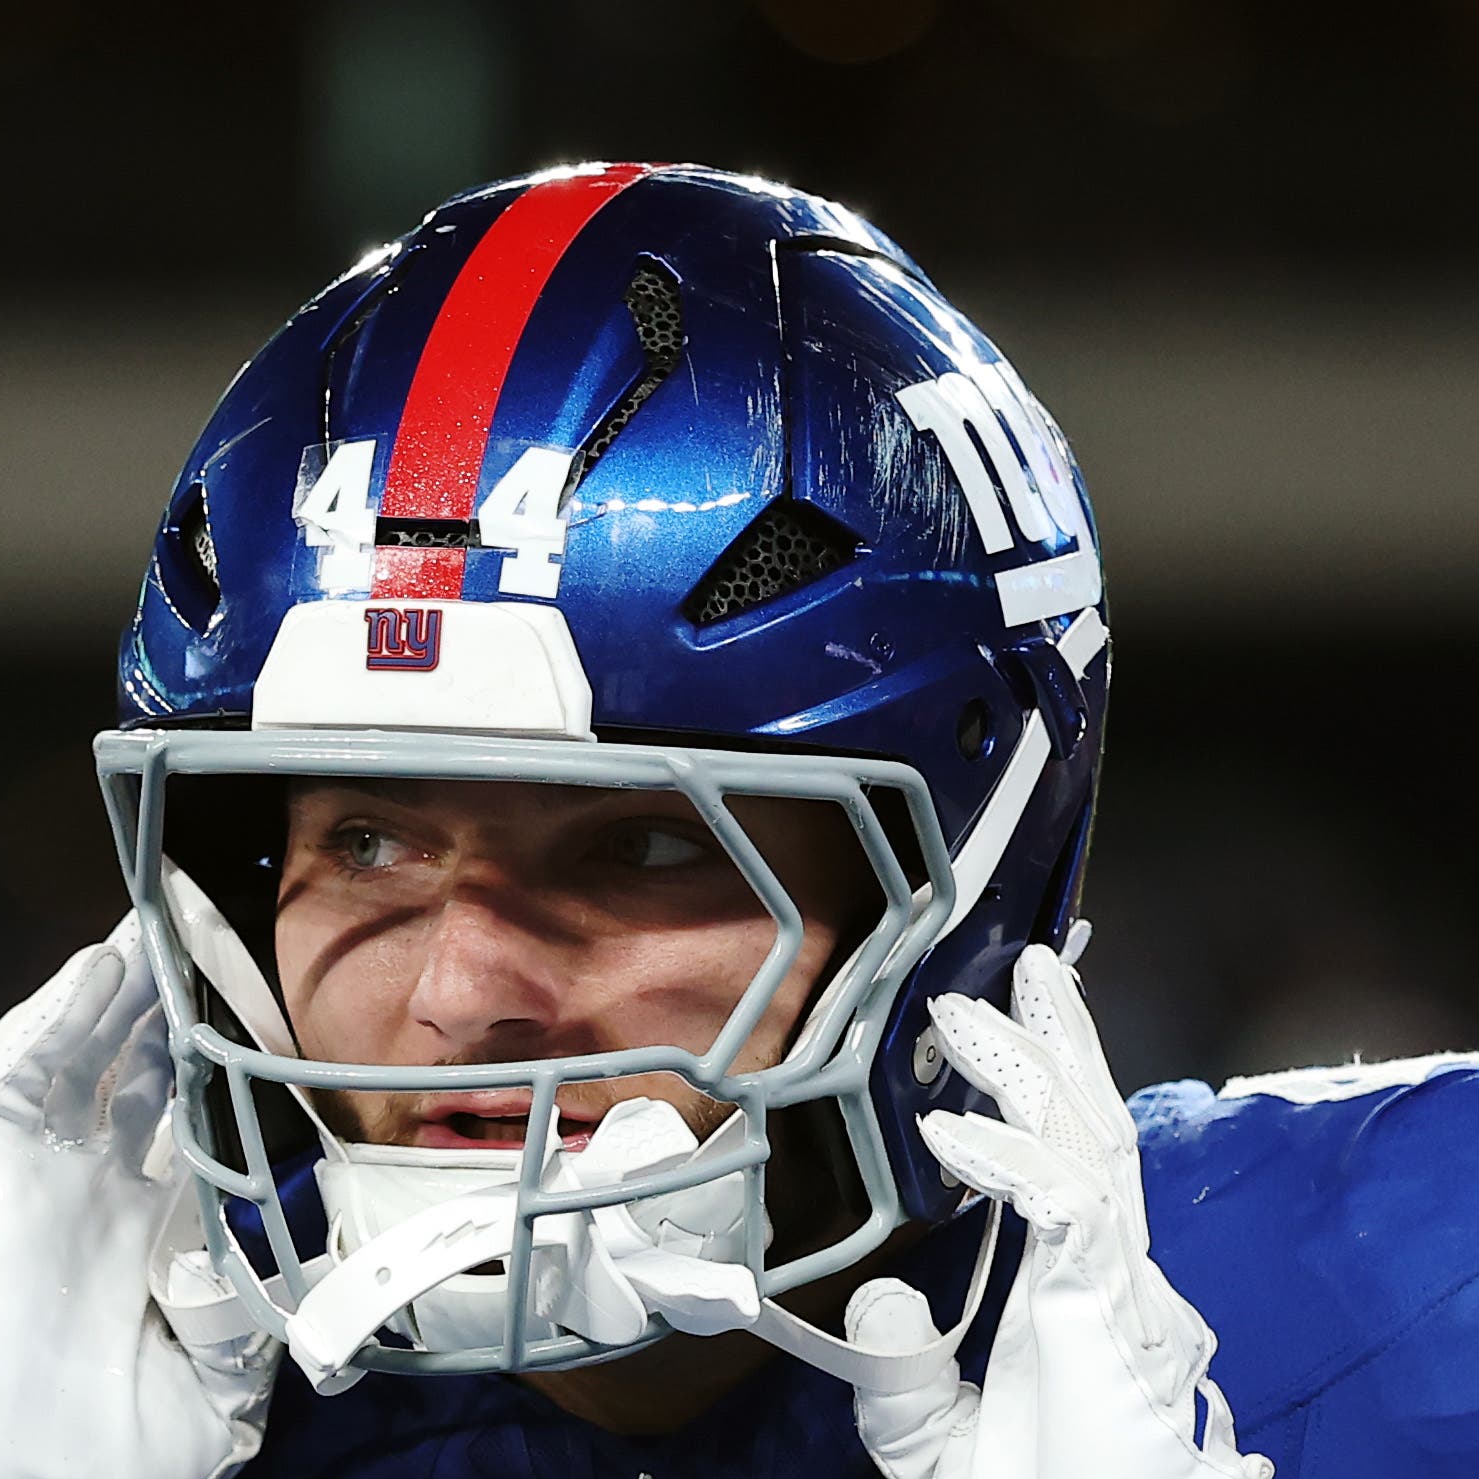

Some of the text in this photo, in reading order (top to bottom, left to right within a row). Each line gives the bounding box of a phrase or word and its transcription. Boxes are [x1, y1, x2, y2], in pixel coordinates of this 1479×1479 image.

[292, 439, 569, 599] 4 4
[364, 607, 443, 672] ny
